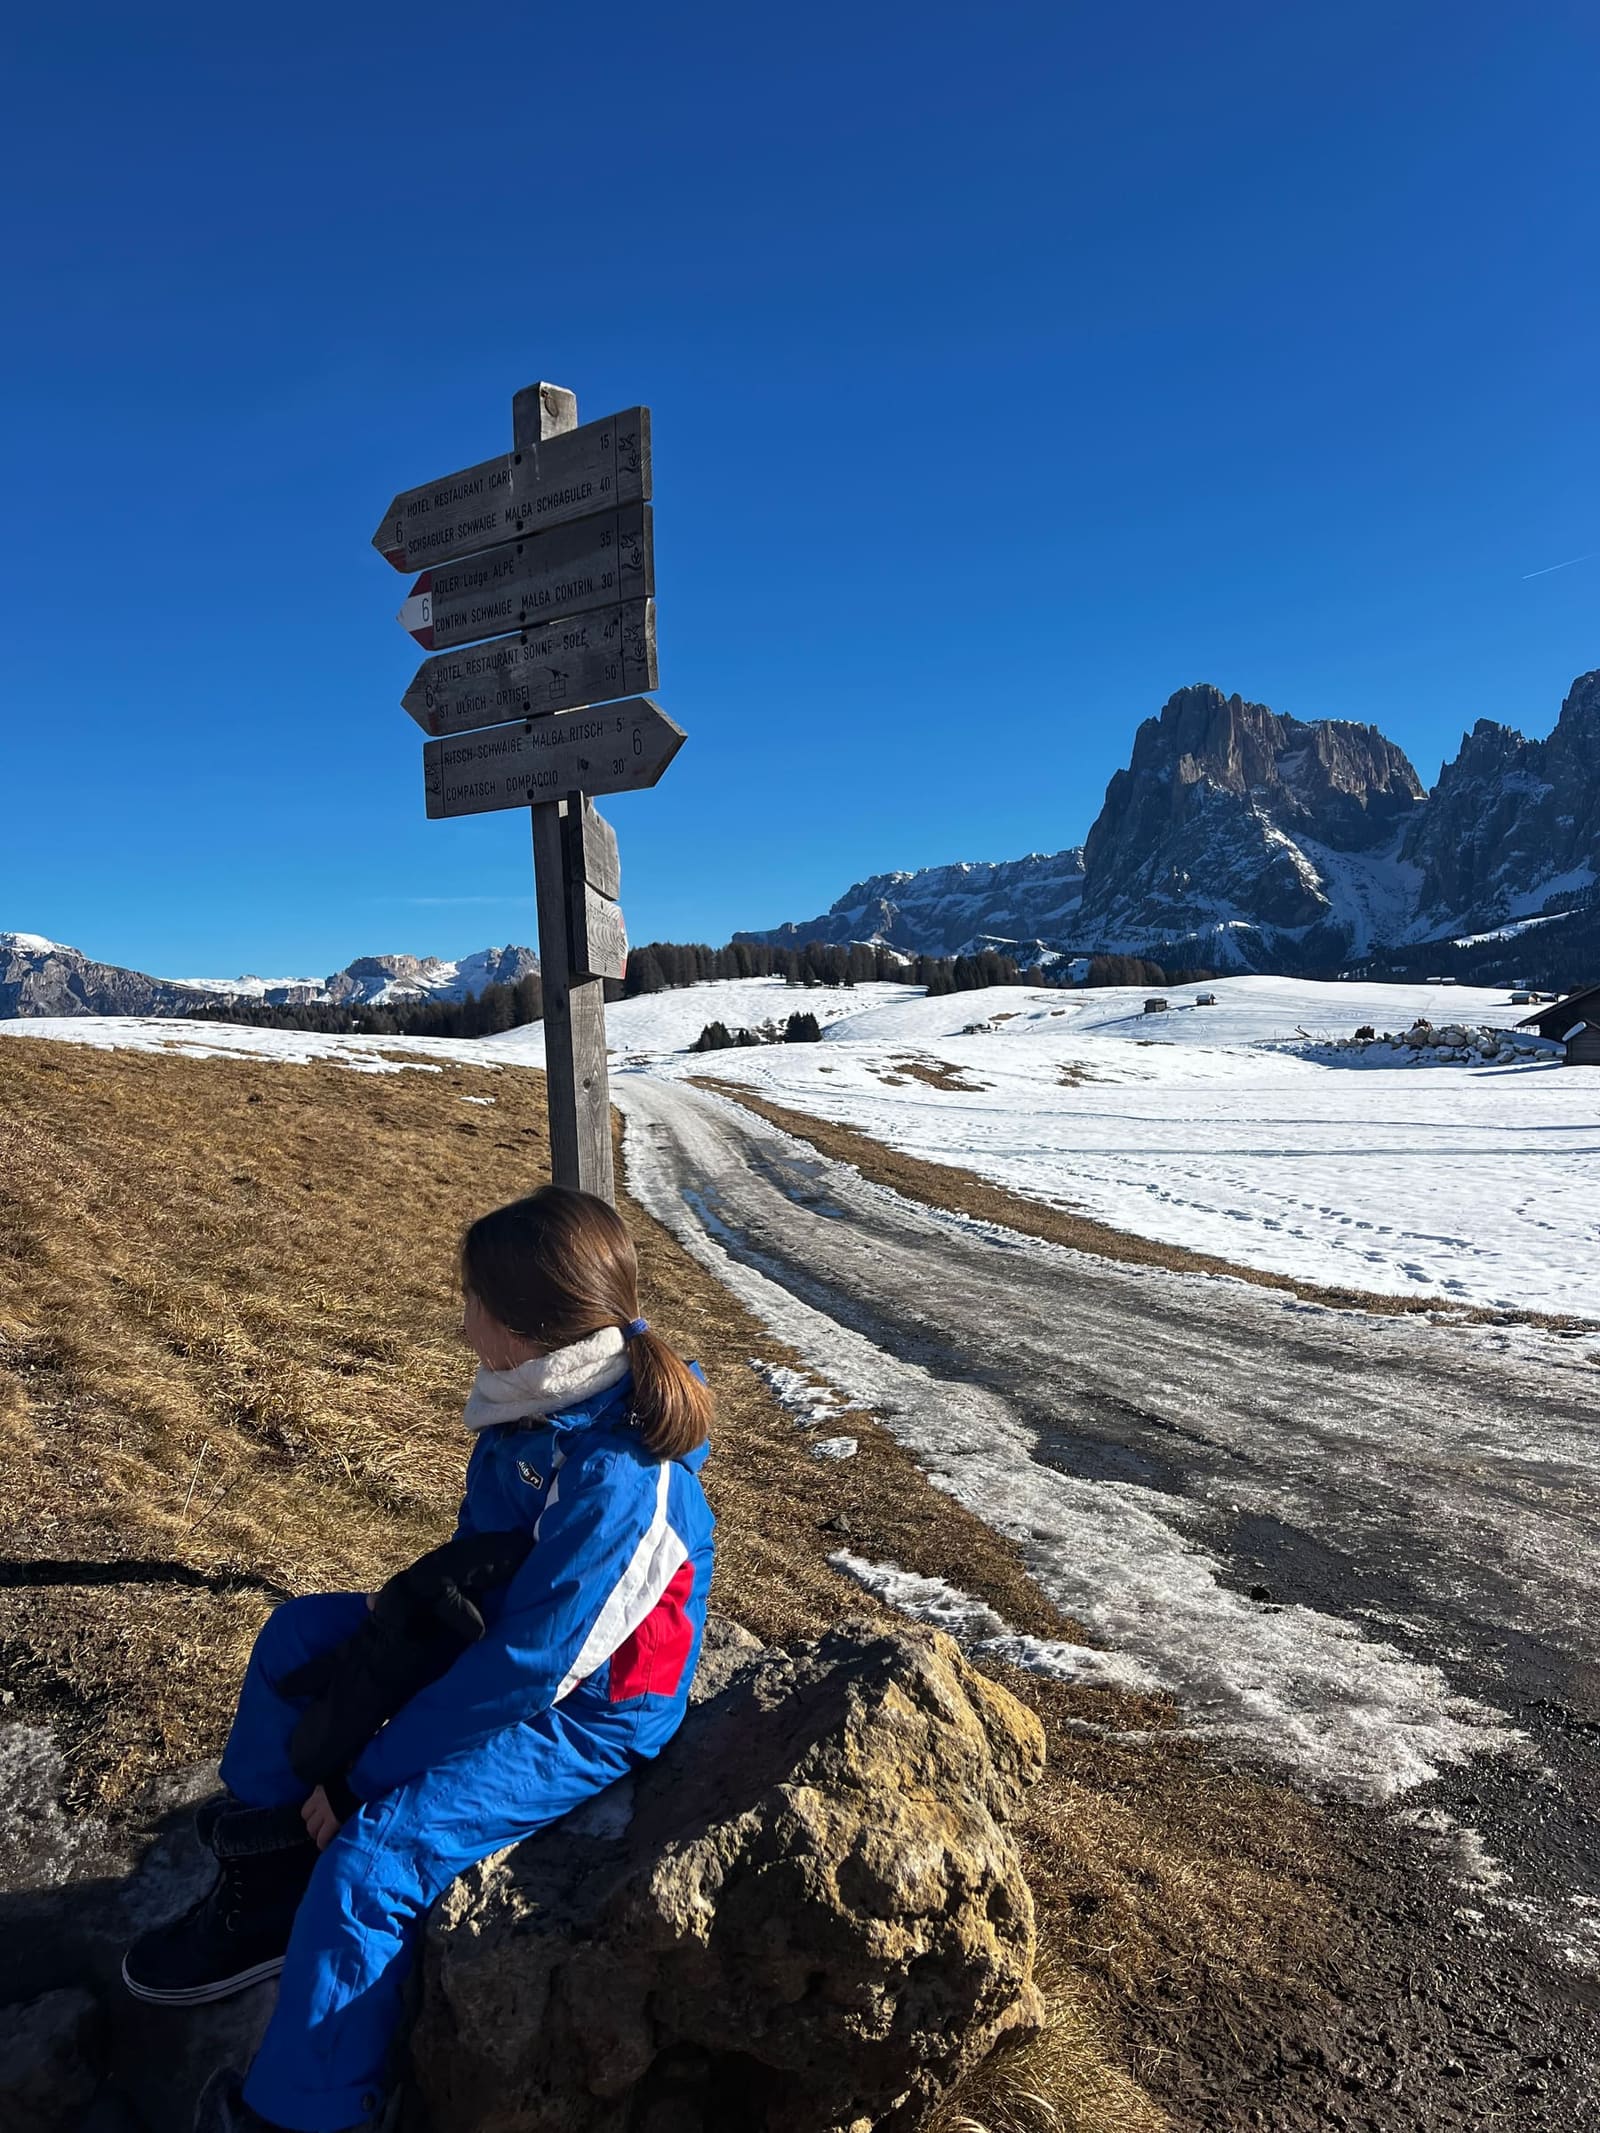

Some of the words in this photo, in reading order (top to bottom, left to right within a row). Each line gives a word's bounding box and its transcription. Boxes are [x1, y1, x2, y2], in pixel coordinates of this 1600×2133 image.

[407, 498, 430, 518] HOTEL
[434, 479, 483, 508] RESTAURANT
[458, 513, 497, 538] SCHWAIGE
[505, 504, 532, 523] MALGA
[537, 483, 592, 513] SCHGAGULER
[395, 521, 403, 543] 6
[434, 576, 459, 596] ADLER
[463, 571, 488, 587] Lodge
[493, 560, 514, 577] ALPE
[422, 598, 430, 622] 6
[435, 614, 467, 632] CONTRIN
[471, 599, 512, 622] SCHWAIGE
[521, 590, 550, 609] MALGA
[555, 576, 592, 601] CONTRIN
[437, 665, 462, 683] HOTEL
[466, 649, 518, 675] RESTAURANT
[524, 640, 552, 660] SONNE
[563, 630, 586, 650] SOLE
[425, 684, 433, 708] 6
[456, 695, 487, 714] ULRICH
[496, 685, 529, 706] ORTISEI
[532, 729, 564, 749] MALGA
[569, 722, 603, 742] RITSCH
[632, 728, 642, 755] 6
[446, 781, 496, 801] COMPATSCH
[506, 770, 558, 792] COMPACCIO
